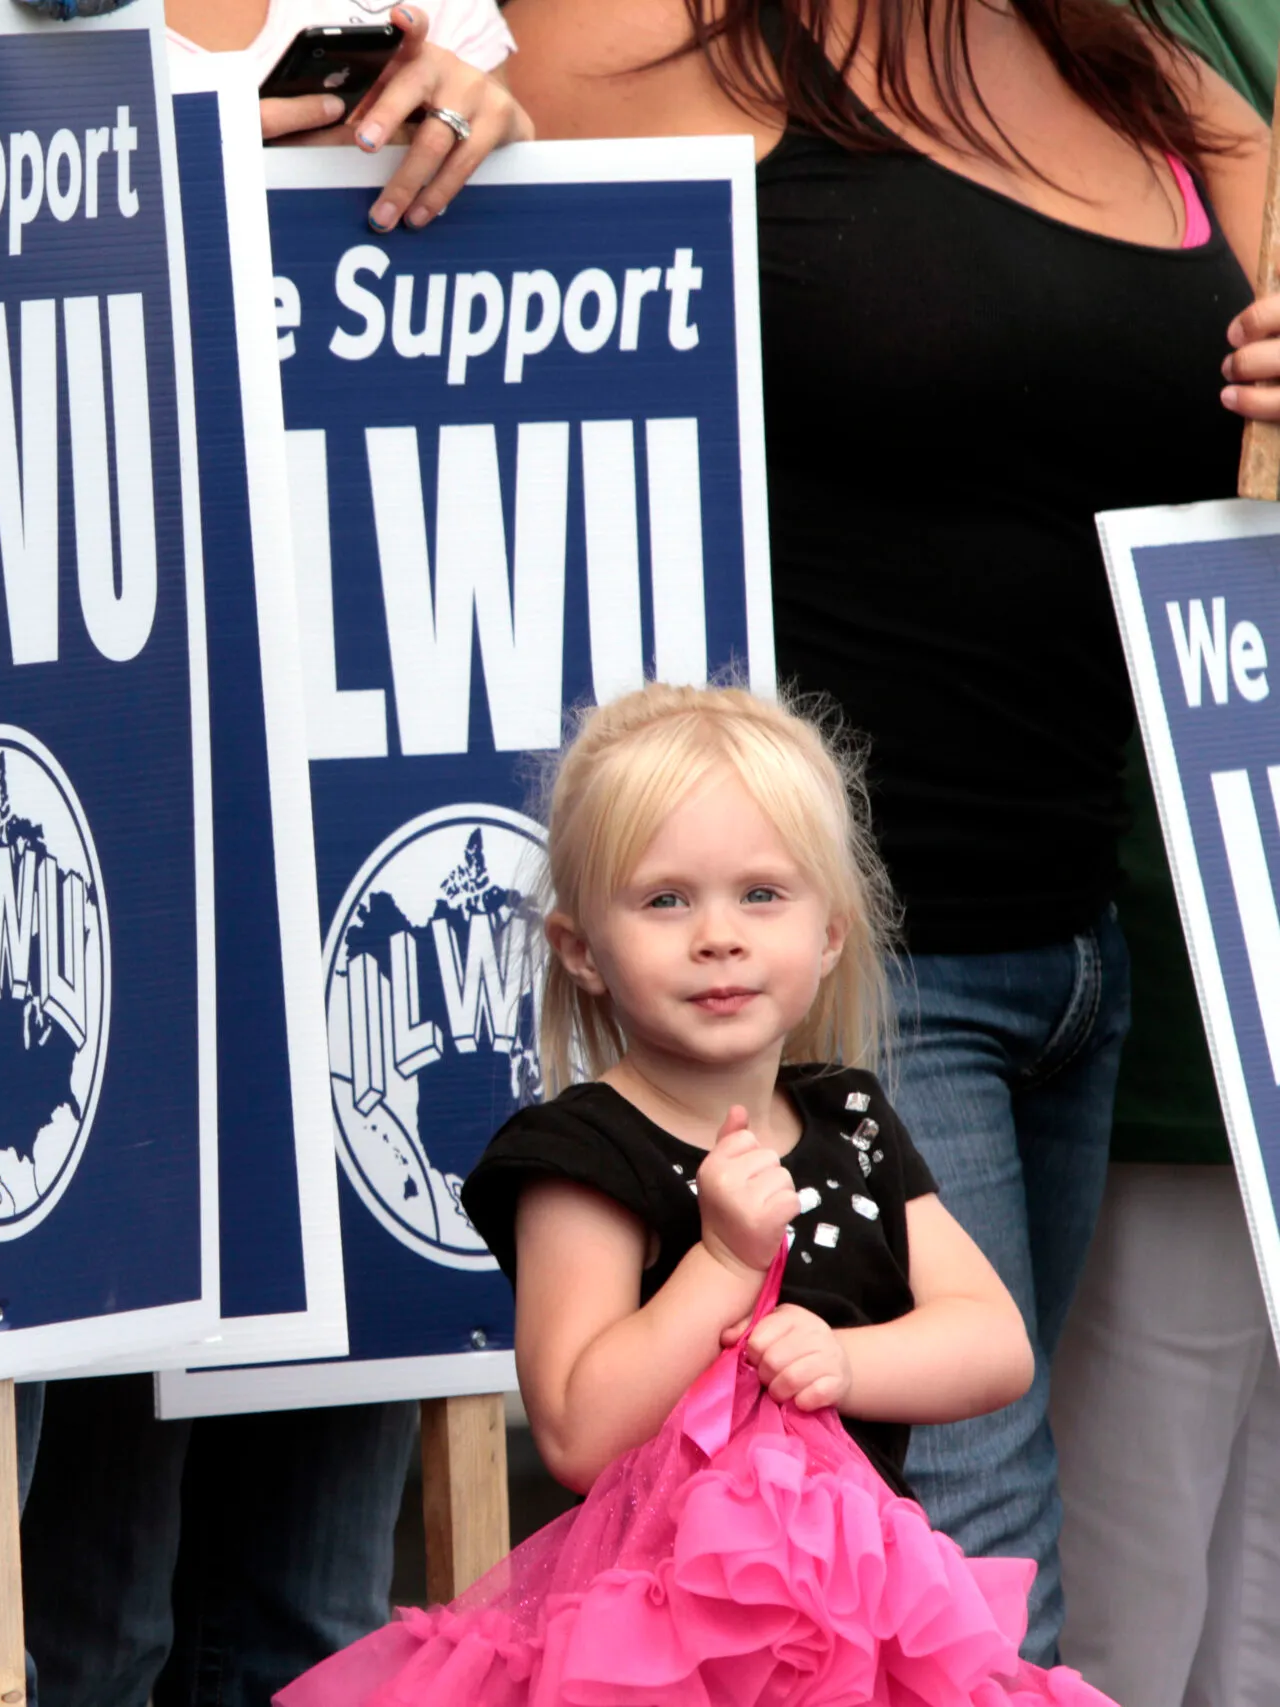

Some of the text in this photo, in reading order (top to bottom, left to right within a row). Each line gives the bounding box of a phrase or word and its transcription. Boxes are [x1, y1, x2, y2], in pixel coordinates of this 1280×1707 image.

[272, 244, 703, 385] e Support
[284, 418, 708, 760] LWU
[1166, 597, 1270, 708] We
[347, 912, 545, 1118] ILW
